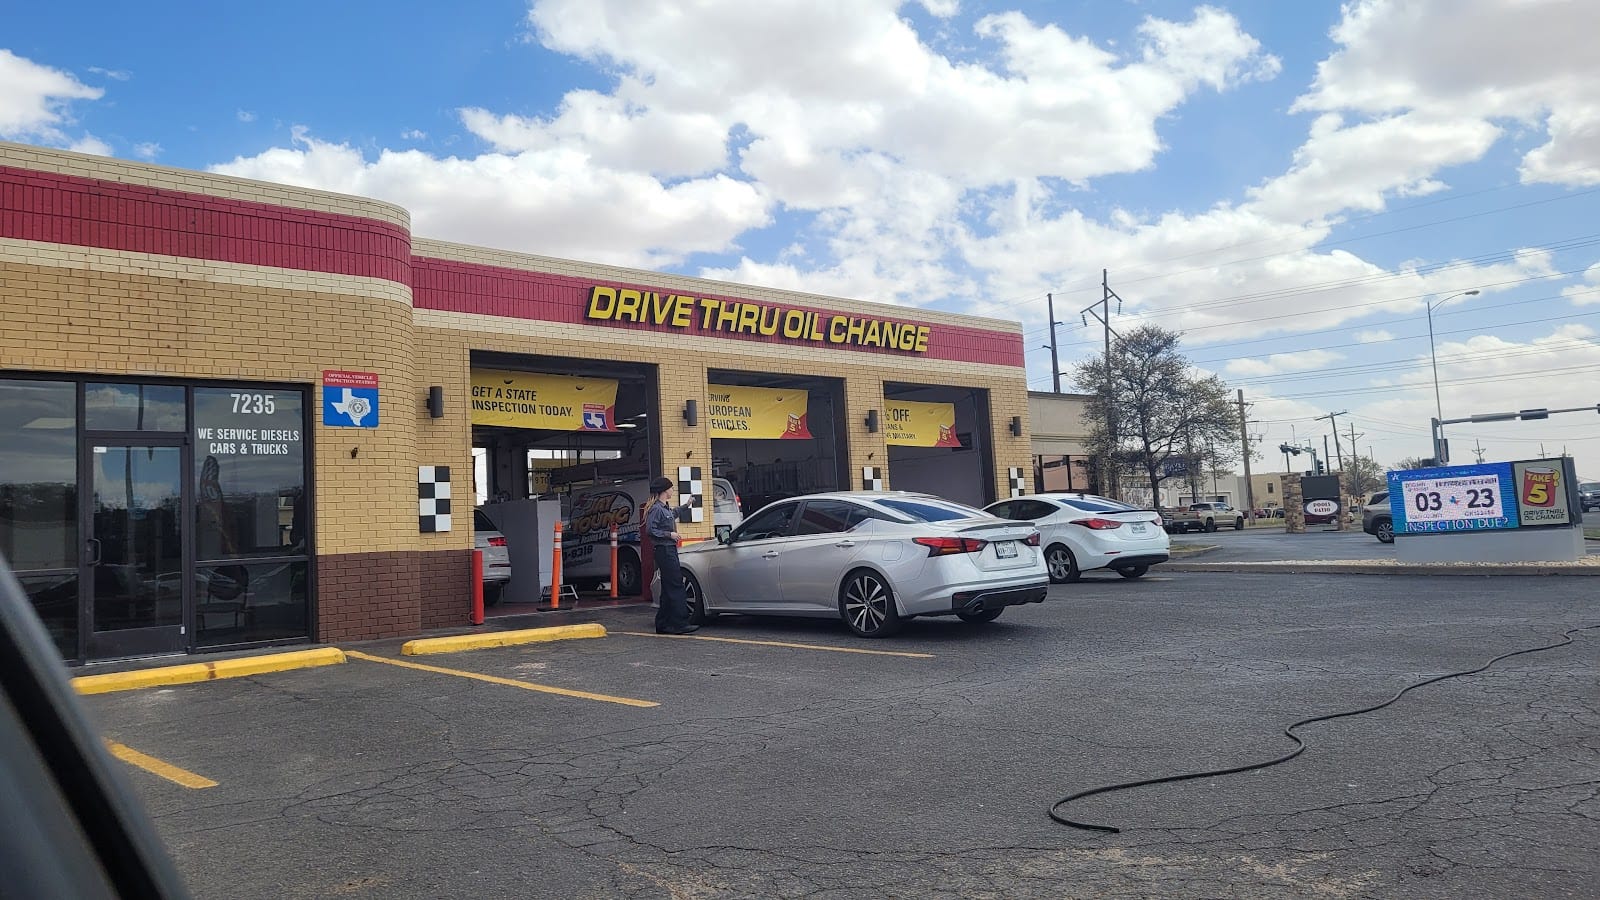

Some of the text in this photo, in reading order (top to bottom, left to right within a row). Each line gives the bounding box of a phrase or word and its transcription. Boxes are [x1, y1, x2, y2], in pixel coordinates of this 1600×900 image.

[587, 286, 931, 353] DRIVE THRU OIL CHANGE
[472, 385, 537, 401] GET A STATE
[230, 393, 275, 414] 7235
[472, 400, 574, 417] INSPECTION TODAY.
[708, 404, 752, 418] UROPEAN
[892, 408, 912, 422] OFF.
[710, 419, 751, 431] EHICLES.
[886, 423, 898, 431] ANS
[198, 428, 300, 442] WE SERVICE DIESELS
[209, 443, 288, 455] CARS & TRUCKS
[1525, 472, 1551, 483] TAKE
[1415, 488, 1495, 513] 03 23
[1527, 483, 1549, 505] 5
[1405, 517, 1508, 532] INSPECTION DUE?
